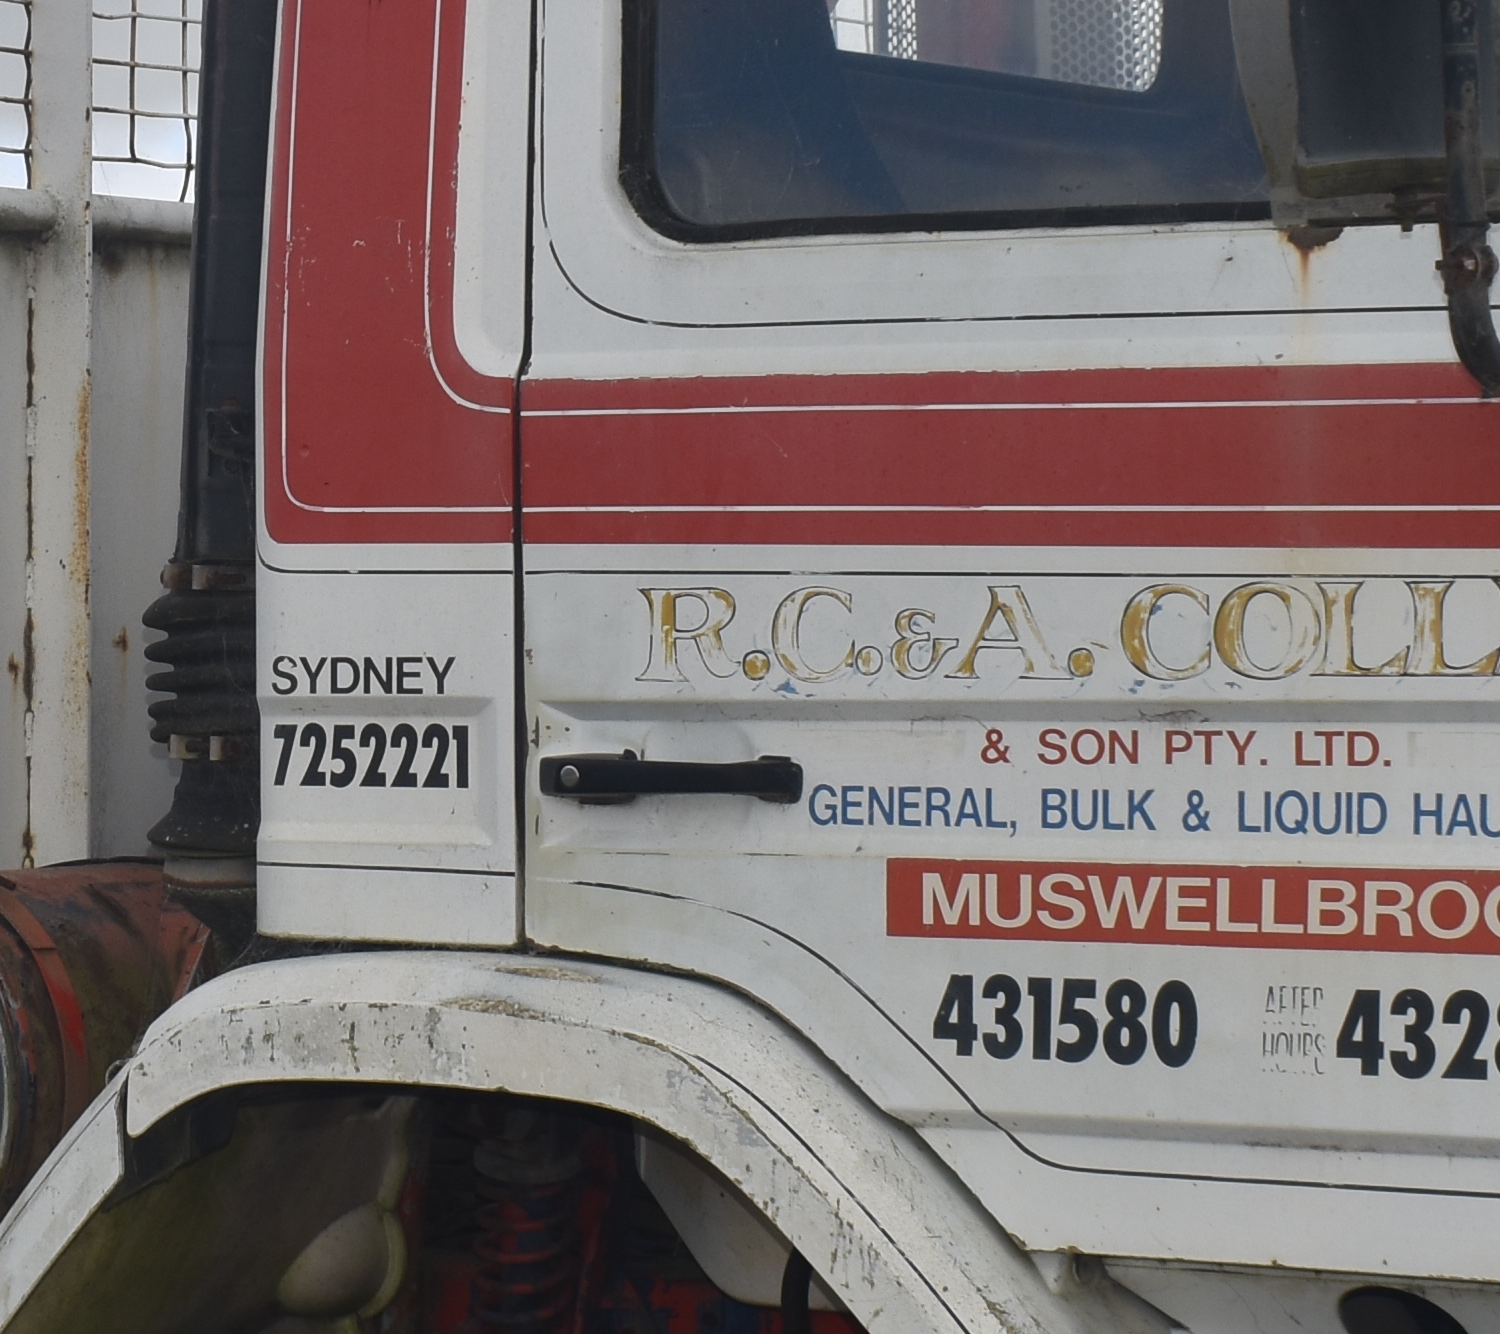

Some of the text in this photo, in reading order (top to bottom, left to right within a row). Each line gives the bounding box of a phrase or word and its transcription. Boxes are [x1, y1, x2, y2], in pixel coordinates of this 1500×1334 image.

[270, 656, 456, 695] SYDNEY
[272, 723, 471, 789] 7252221
[980, 728, 1392, 768] & SON PTY. LTD.
[808, 783, 1018, 838] GENERAL,
[1040, 788, 1157, 832] BULK
[1181, 789, 1211, 833] &
[1238, 790, 1388, 837] LIQUID
[932, 974, 1198, 1068] 431580
